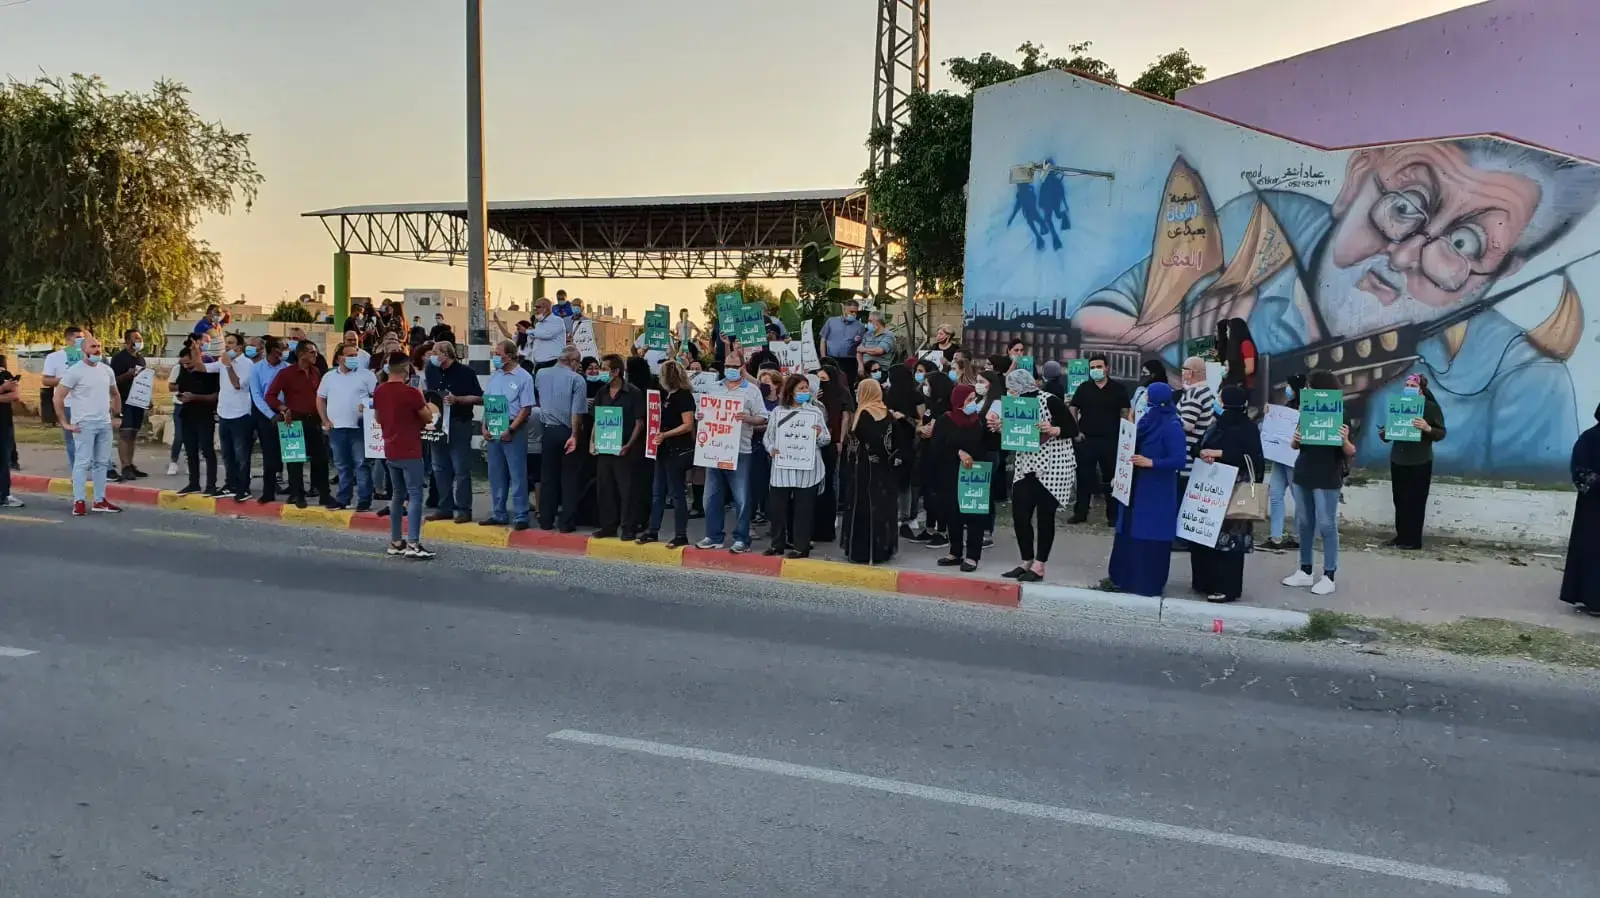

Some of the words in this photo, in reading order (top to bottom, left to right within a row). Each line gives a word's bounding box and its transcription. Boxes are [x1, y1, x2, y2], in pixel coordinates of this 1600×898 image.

[736, 310, 763, 323] النهاية
[742, 324, 758, 334] للعنف
[739, 336, 754, 344] النساء
[700, 396, 721, 408] נשים
[726, 400, 741, 410] דם
[1303, 400, 1342, 416] النهاية
[1390, 404, 1422, 416] النهاية
[1004, 408, 1038, 422] النهاية
[597, 416, 622, 429] النهاية
[1310, 416, 1334, 428] للعنف
[1394, 418, 1414, 426] للعنف
[704, 422, 732, 437] הפקר
[1010, 424, 1032, 434] للعنف
[1386, 428, 1406, 436] النساء
[600, 430, 616, 439] للعنف
[1301, 430, 1325, 440] النساء
[594, 440, 610, 450] النساء
[1002, 436, 1024, 446] النساء
[1026, 438, 1039, 448] ضد
[960, 472, 990, 485] النهاية
[964, 488, 982, 497] للعنف
[960, 498, 976, 509] النساء
